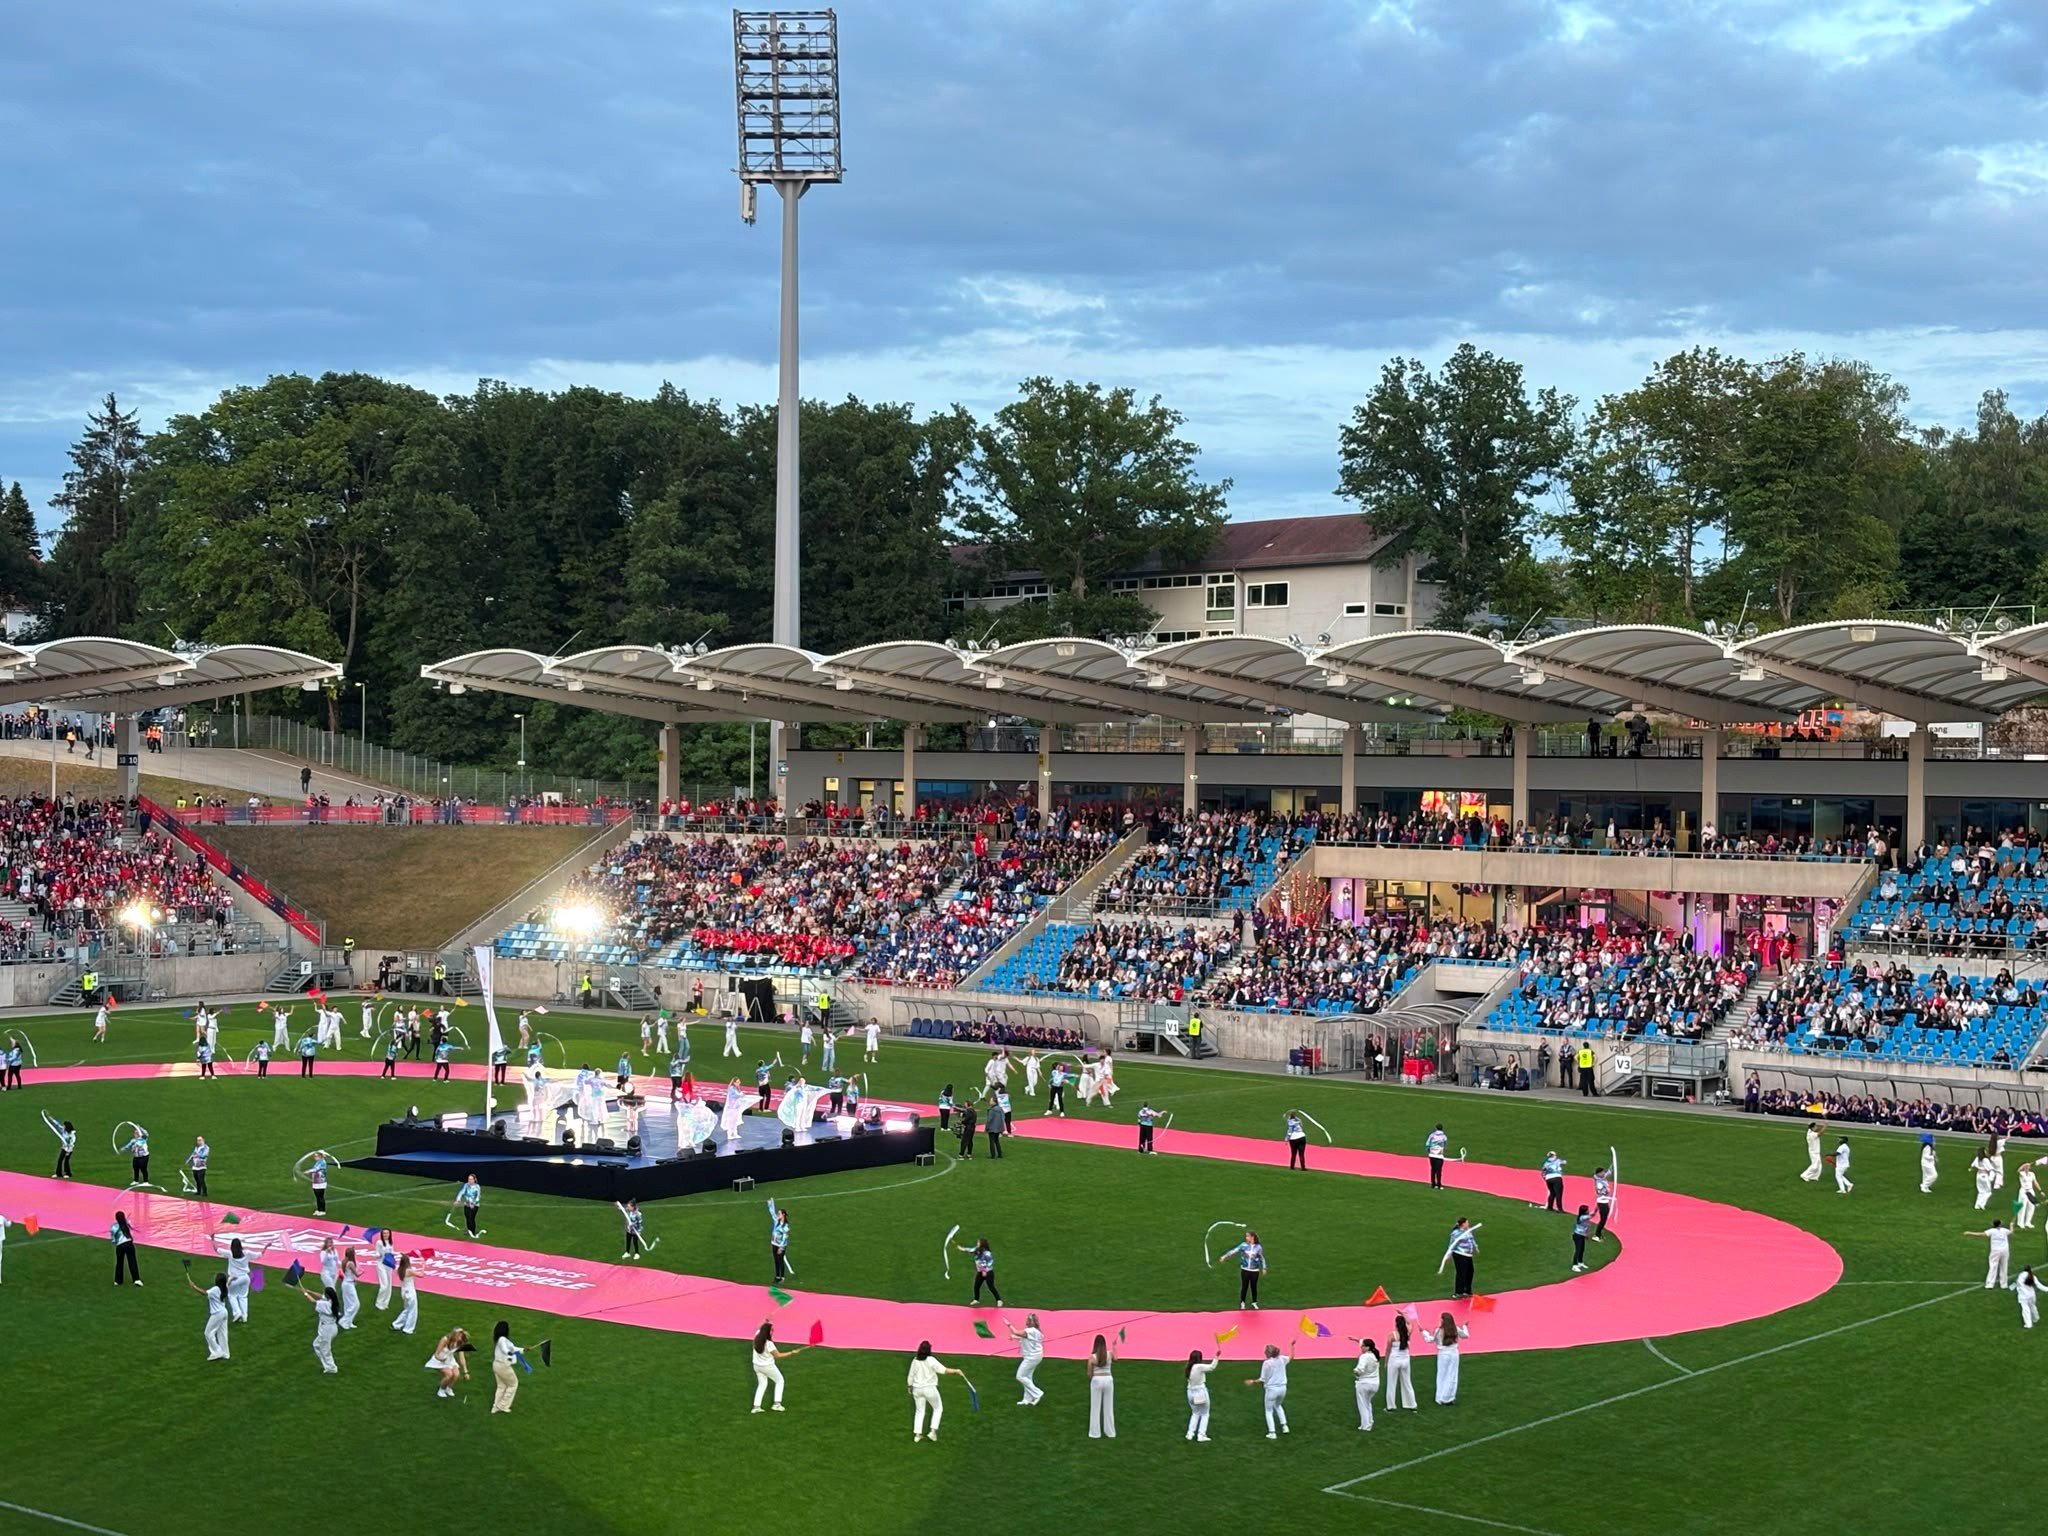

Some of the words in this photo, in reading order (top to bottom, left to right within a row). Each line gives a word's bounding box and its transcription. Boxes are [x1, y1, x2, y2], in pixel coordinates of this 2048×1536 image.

[129, 756, 138, 764] 10
[611, 980, 620, 988] H2
[809, 995, 819, 1003] H3
[1167, 1023, 1178, 1032] V1
[1616, 1059, 1631, 1070] V3
[486, 1260, 588, 1279] OLYMPICS
[461, 1276, 517, 1288] 2026
[492, 1271, 597, 1290] SPIELE
